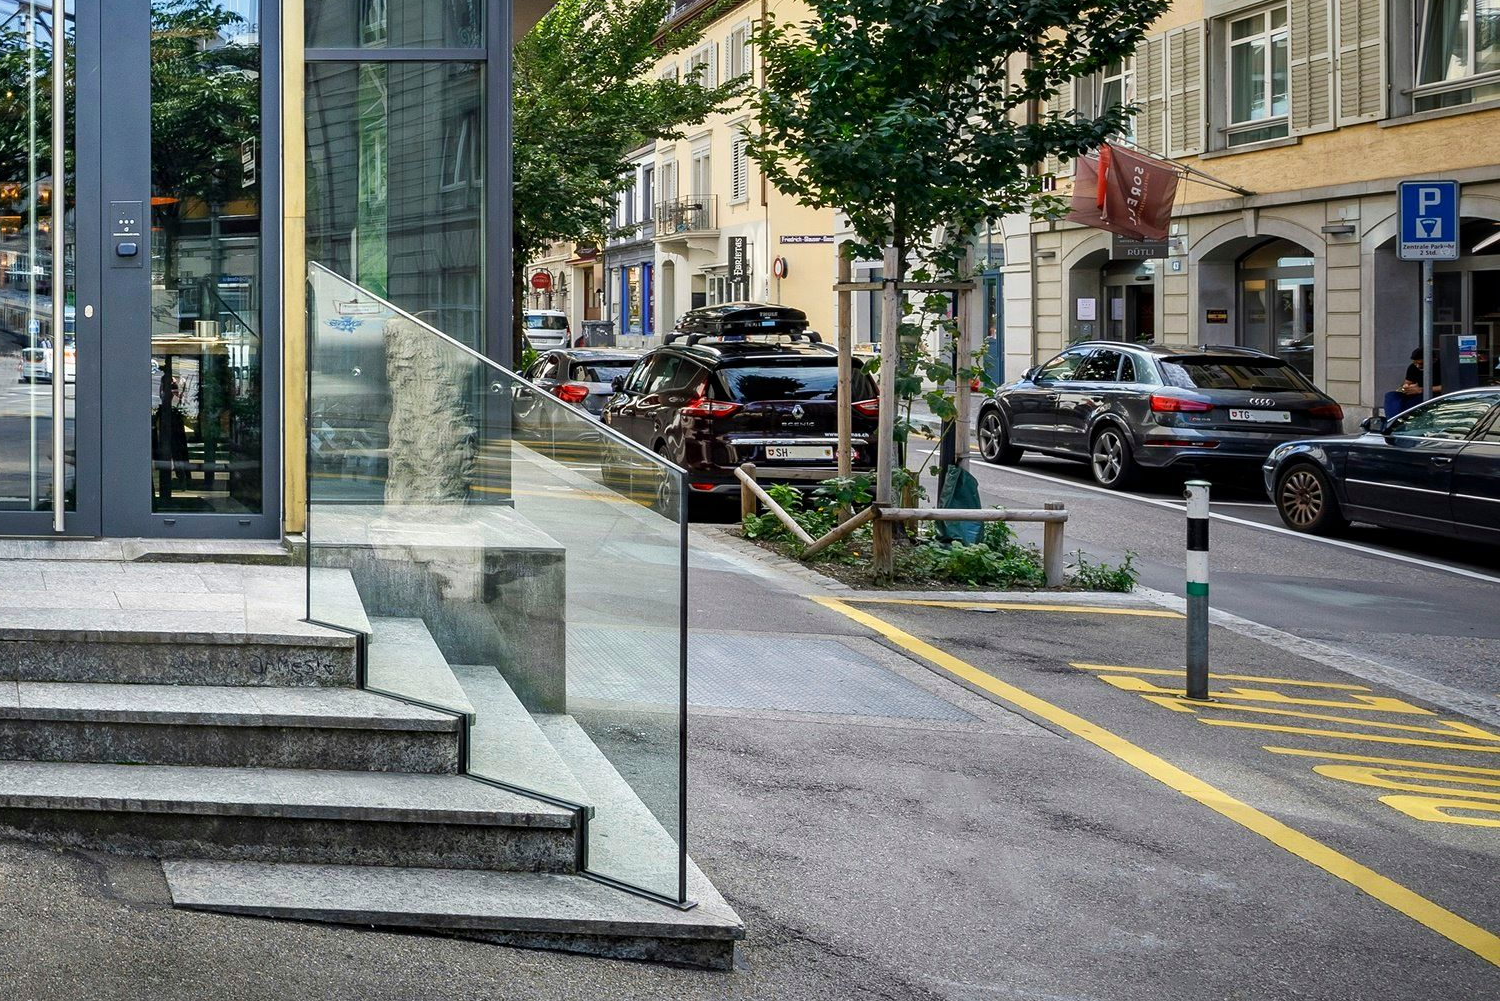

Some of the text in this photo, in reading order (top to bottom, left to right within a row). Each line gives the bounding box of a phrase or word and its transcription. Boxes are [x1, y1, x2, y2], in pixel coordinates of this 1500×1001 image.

[1418, 187, 1441, 216] P
[1127, 247, 1155, 256] RÜTLI
[1238, 410, 1250, 419] TG
[776, 448, 788, 458] SH
